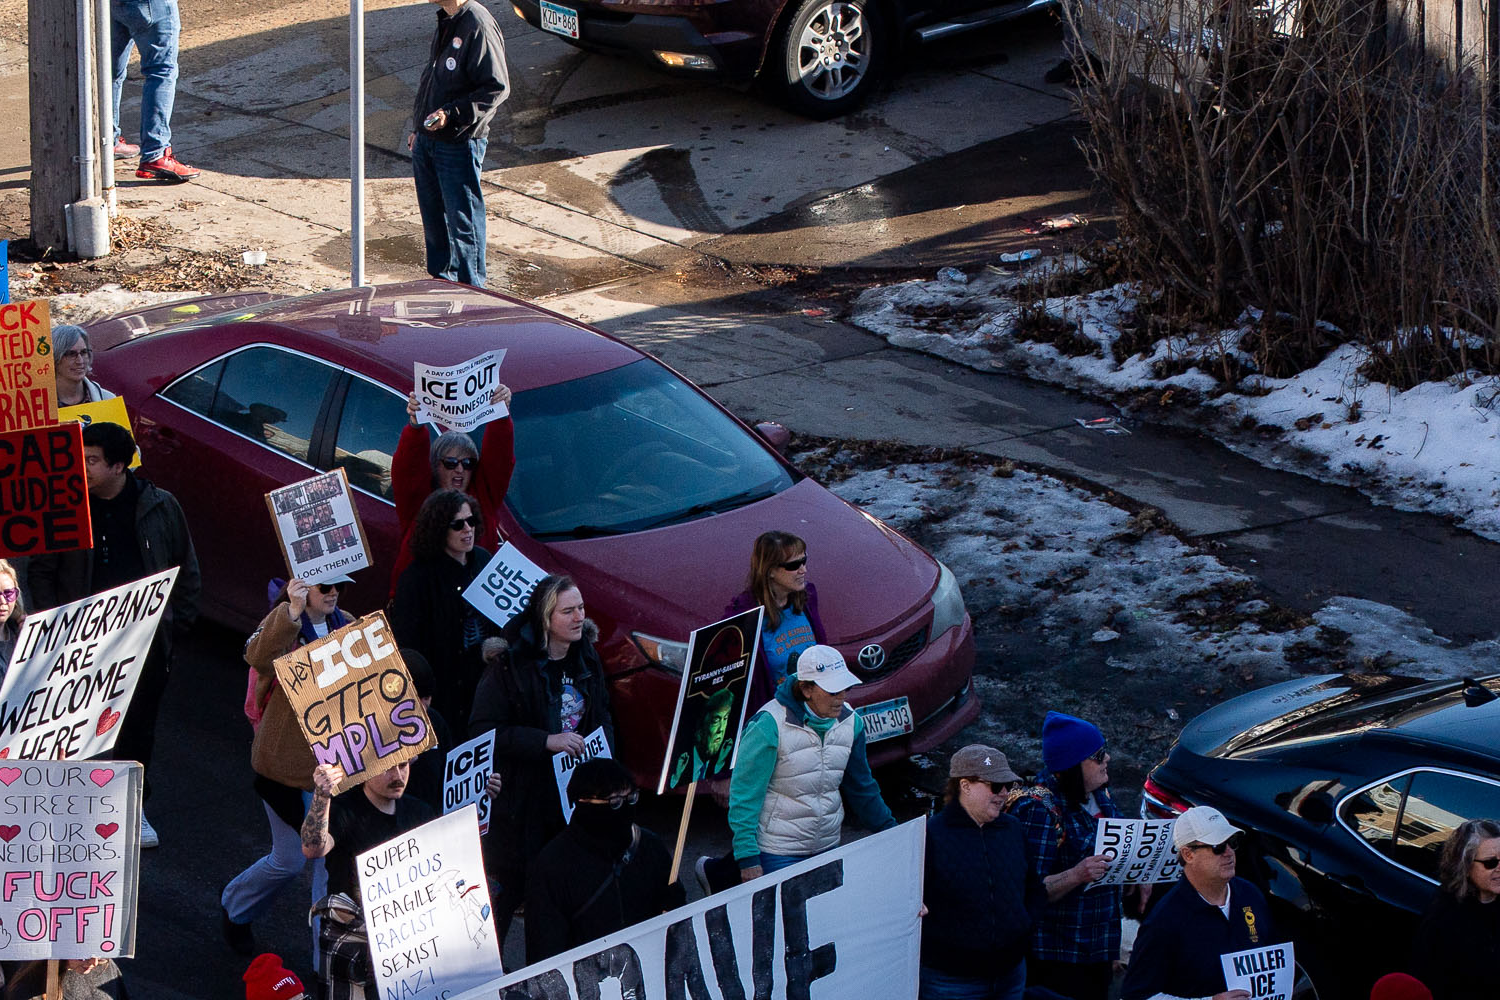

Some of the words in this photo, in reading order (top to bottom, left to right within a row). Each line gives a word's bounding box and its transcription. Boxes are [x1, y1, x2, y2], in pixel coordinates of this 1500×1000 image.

[542, 8, 557, 25] KZD
[562, 15, 577, 32] 868
[36, 363, 51, 376] of
[421, 376, 458, 401] ICE
[464, 362, 497, 397] OUT
[422, 396, 438, 408] OF
[440, 388, 495, 416] MINNESOTA
[297, 564, 324, 580] LOCK
[323, 556, 350, 573] THEM
[351, 551, 364, 564] UP
[481, 560, 514, 598] ICE
[493, 569, 528, 612] OUT
[15, 577, 171, 665] IMMIGRANTS
[47, 642, 99, 682] ARE
[285, 650, 317, 696] Hey
[310, 618, 396, 689] ICE
[303, 667, 408, 737] GTFO
[887, 707, 911, 729] 303
[18, 718, 90, 761] HERE
[311, 699, 428, 777] MPLS
[24, 766, 87, 788] OUR
[446, 740, 492, 783] ICE
[4, 794, 120, 816] STREETS.
[445, 776, 472, 810] OUT
[28, 820, 87, 843] OUR
[1115, 822, 1136, 875] MINNESOTA
[1149, 822, 1172, 874] MINNESOTA
[364, 837, 420, 878] SUPER
[1123, 857, 1146, 884] ICE
[1137, 822, 1160, 861] OUT
[1157, 857, 1177, 882] ICE
[2, 870, 118, 903] FUCK
[367, 853, 443, 903] CALLOUS
[371, 882, 437, 928] FRAGILE
[16, 902, 116, 952] OFF!
[375, 907, 437, 953] RACIST
[382, 935, 440, 978] SEXIST
[1232, 948, 1286, 977] KILLER
[1250, 972, 1277, 999] ICE
